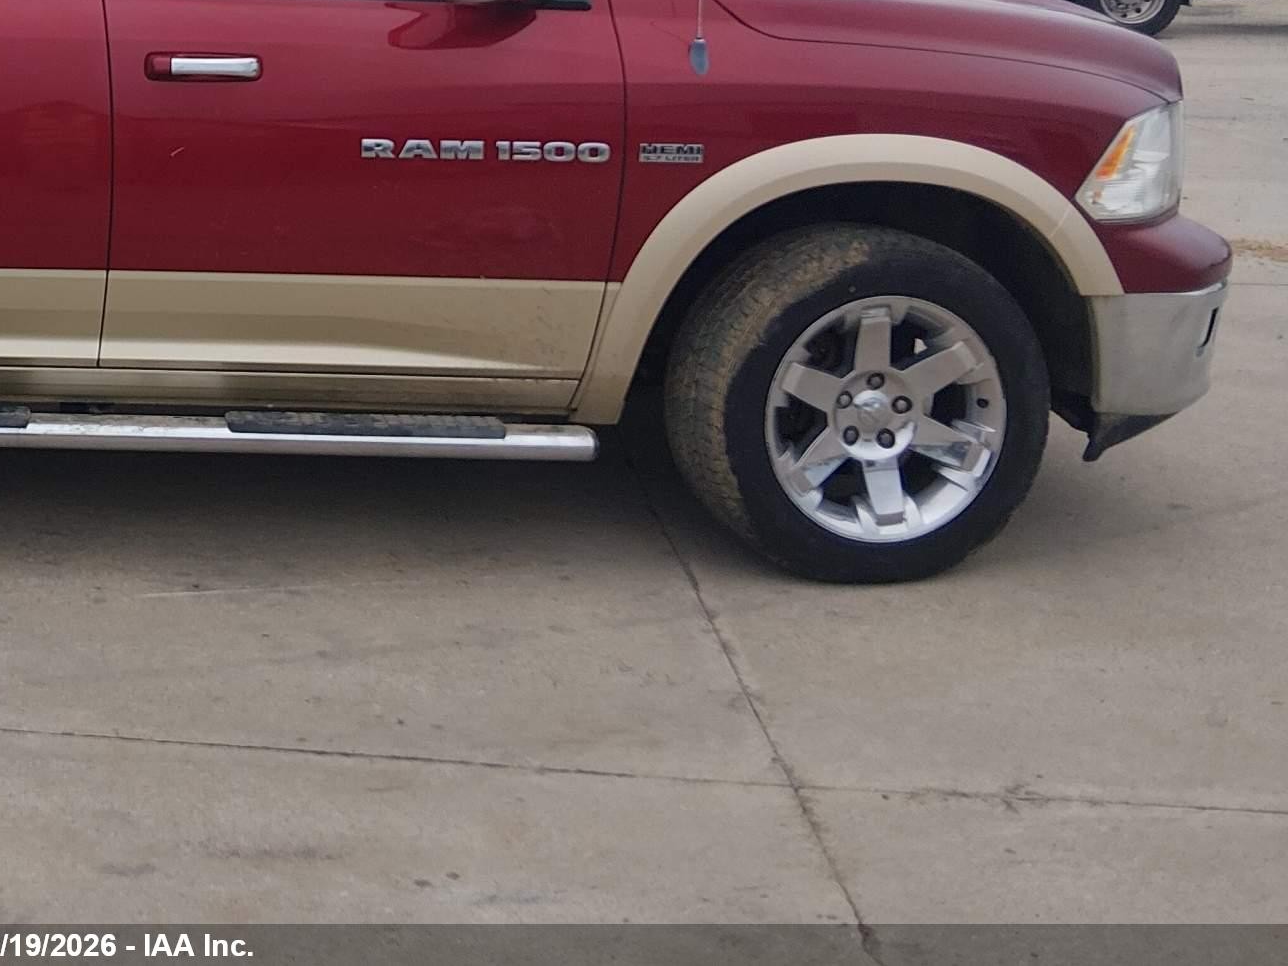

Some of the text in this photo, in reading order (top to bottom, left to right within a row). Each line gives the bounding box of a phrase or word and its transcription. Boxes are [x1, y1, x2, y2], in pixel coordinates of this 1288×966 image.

[360, 138, 612, 164] RAM 1500
[641, 144, 703, 155] HEMI
